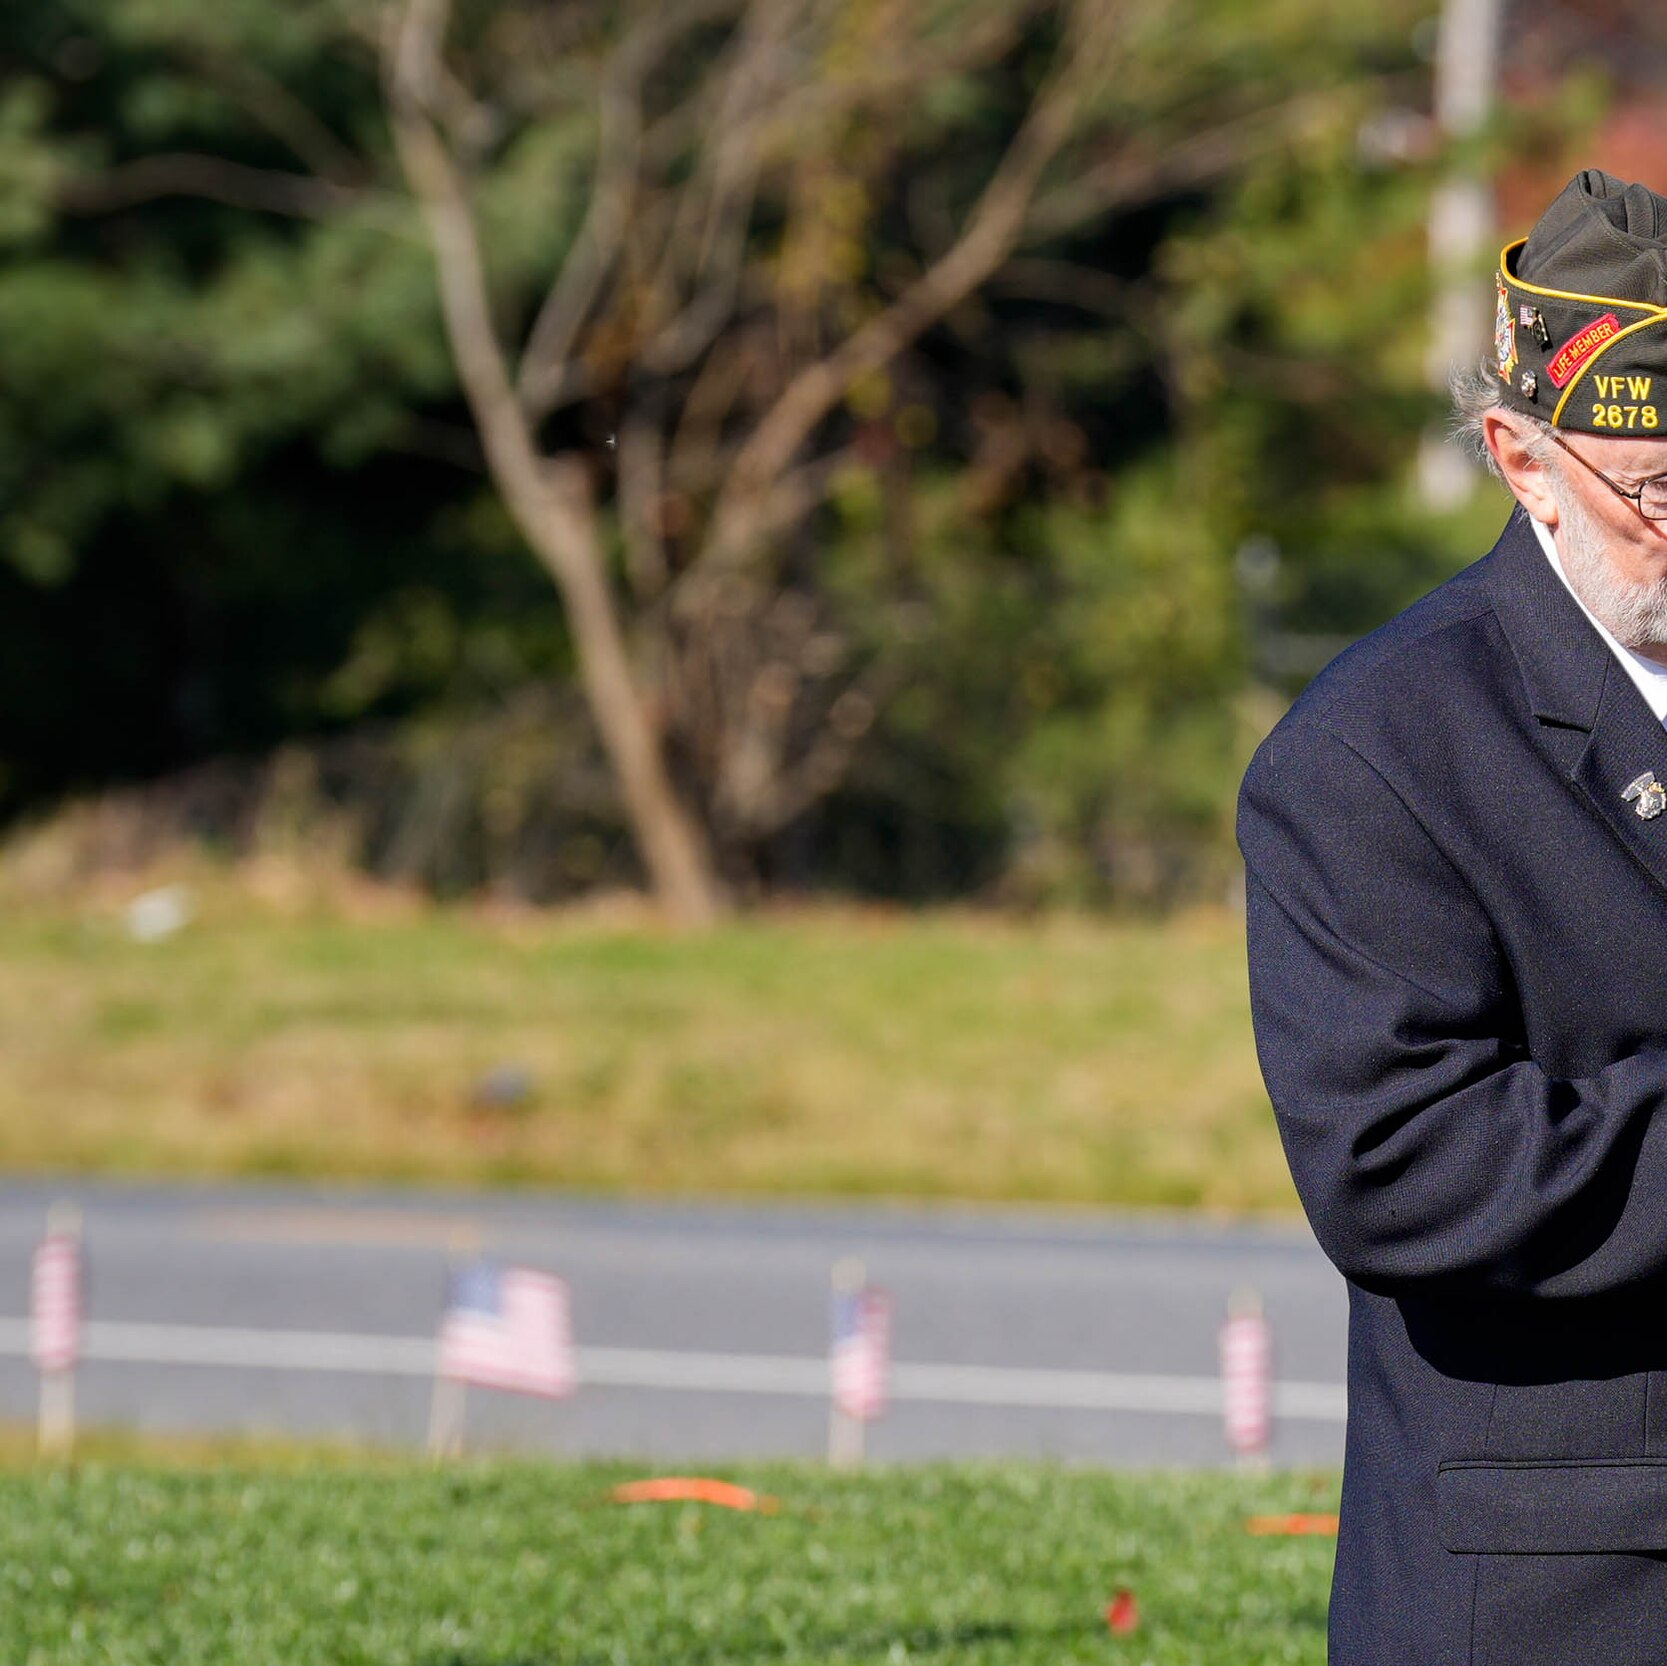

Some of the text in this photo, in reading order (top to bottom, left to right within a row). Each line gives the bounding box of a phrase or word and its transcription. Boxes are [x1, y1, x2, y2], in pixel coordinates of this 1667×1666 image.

[1554, 322, 1614, 379] LIFE MEMBER
[1593, 375, 1651, 400] VFW
[1592, 403, 1658, 429] 2678
